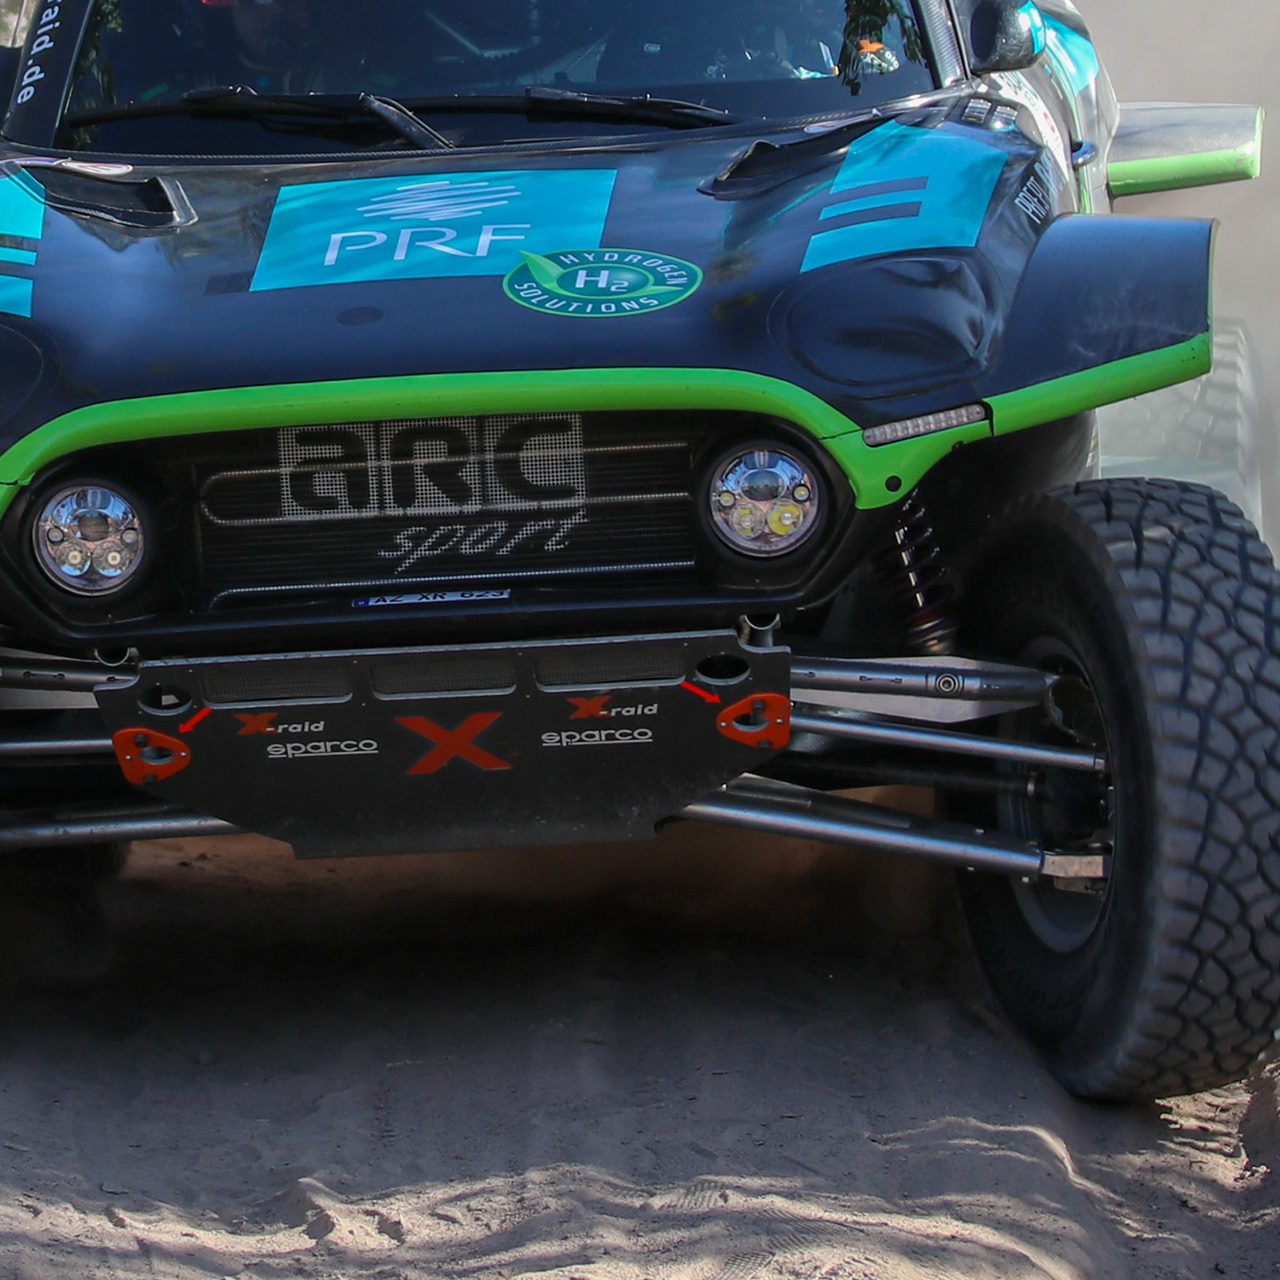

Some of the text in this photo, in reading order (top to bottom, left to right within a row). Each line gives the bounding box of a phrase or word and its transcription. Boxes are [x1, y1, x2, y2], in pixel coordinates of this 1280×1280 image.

[323, 223, 532, 267] PRF
[559, 252, 689, 286] HYDROGEN
[514, 281, 659, 313] SOLUTIONS
[377, 508, 588, 574] sport
[267, 739, 379, 759] sparco
[394, 711, 514, 776] X
[541, 727, 653, 747] sparco
